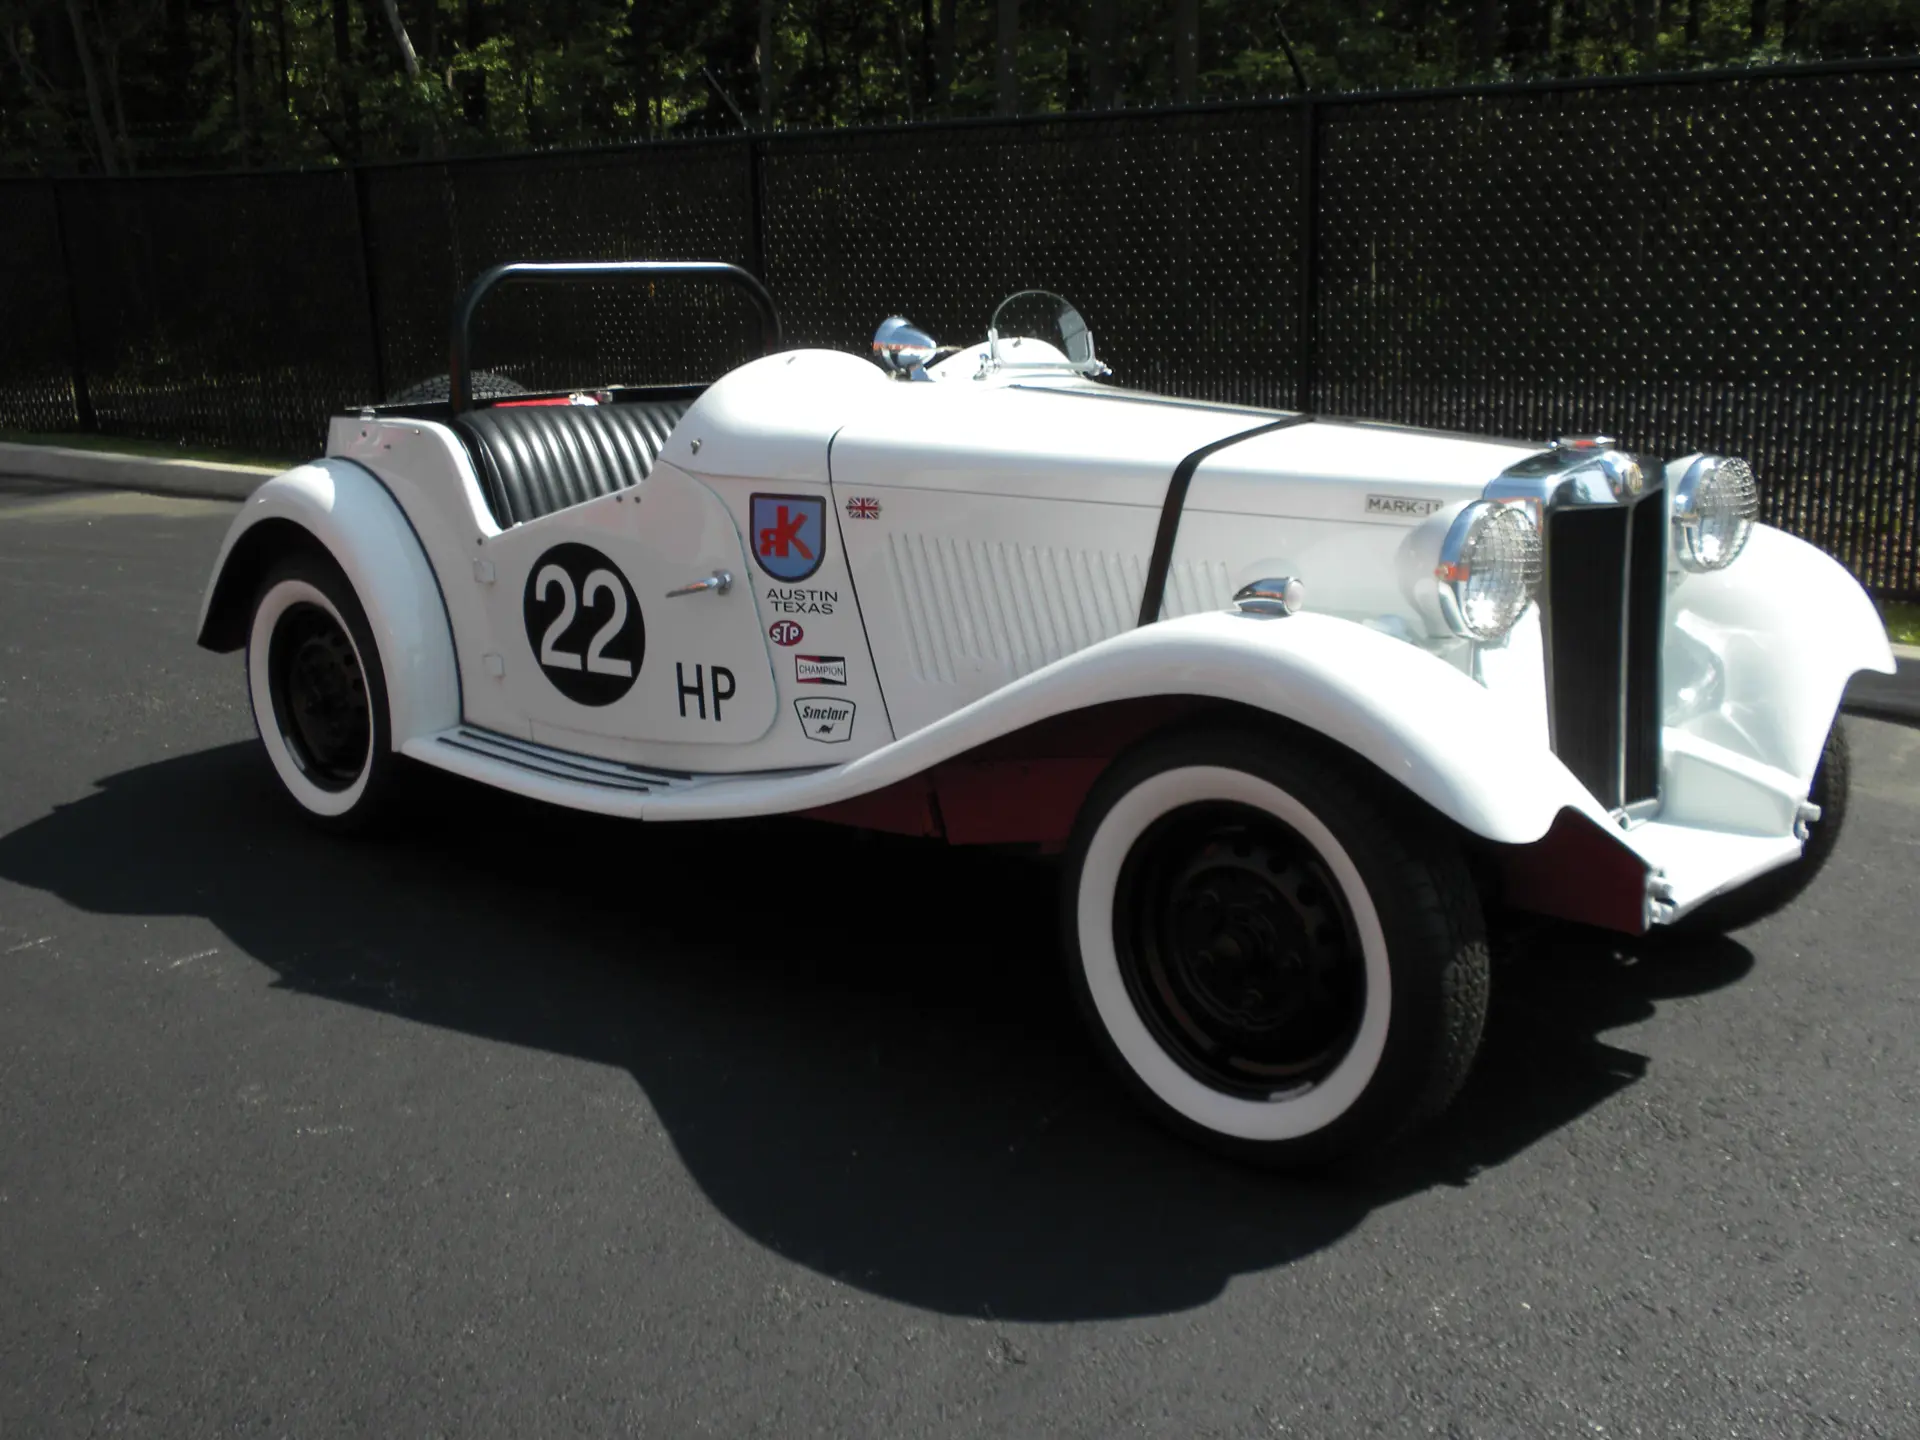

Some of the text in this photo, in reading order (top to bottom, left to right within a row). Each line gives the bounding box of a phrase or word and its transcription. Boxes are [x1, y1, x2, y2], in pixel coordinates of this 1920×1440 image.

[767, 588, 838, 602] AUSTIN
[770, 601, 834, 615] TEXAS
[535, 564, 633, 678] 22
[772, 623, 800, 644] STP
[799, 664, 844, 677] CHAMPION
[676, 662, 736, 722] HP
[802, 706, 849, 721] Sinclair
